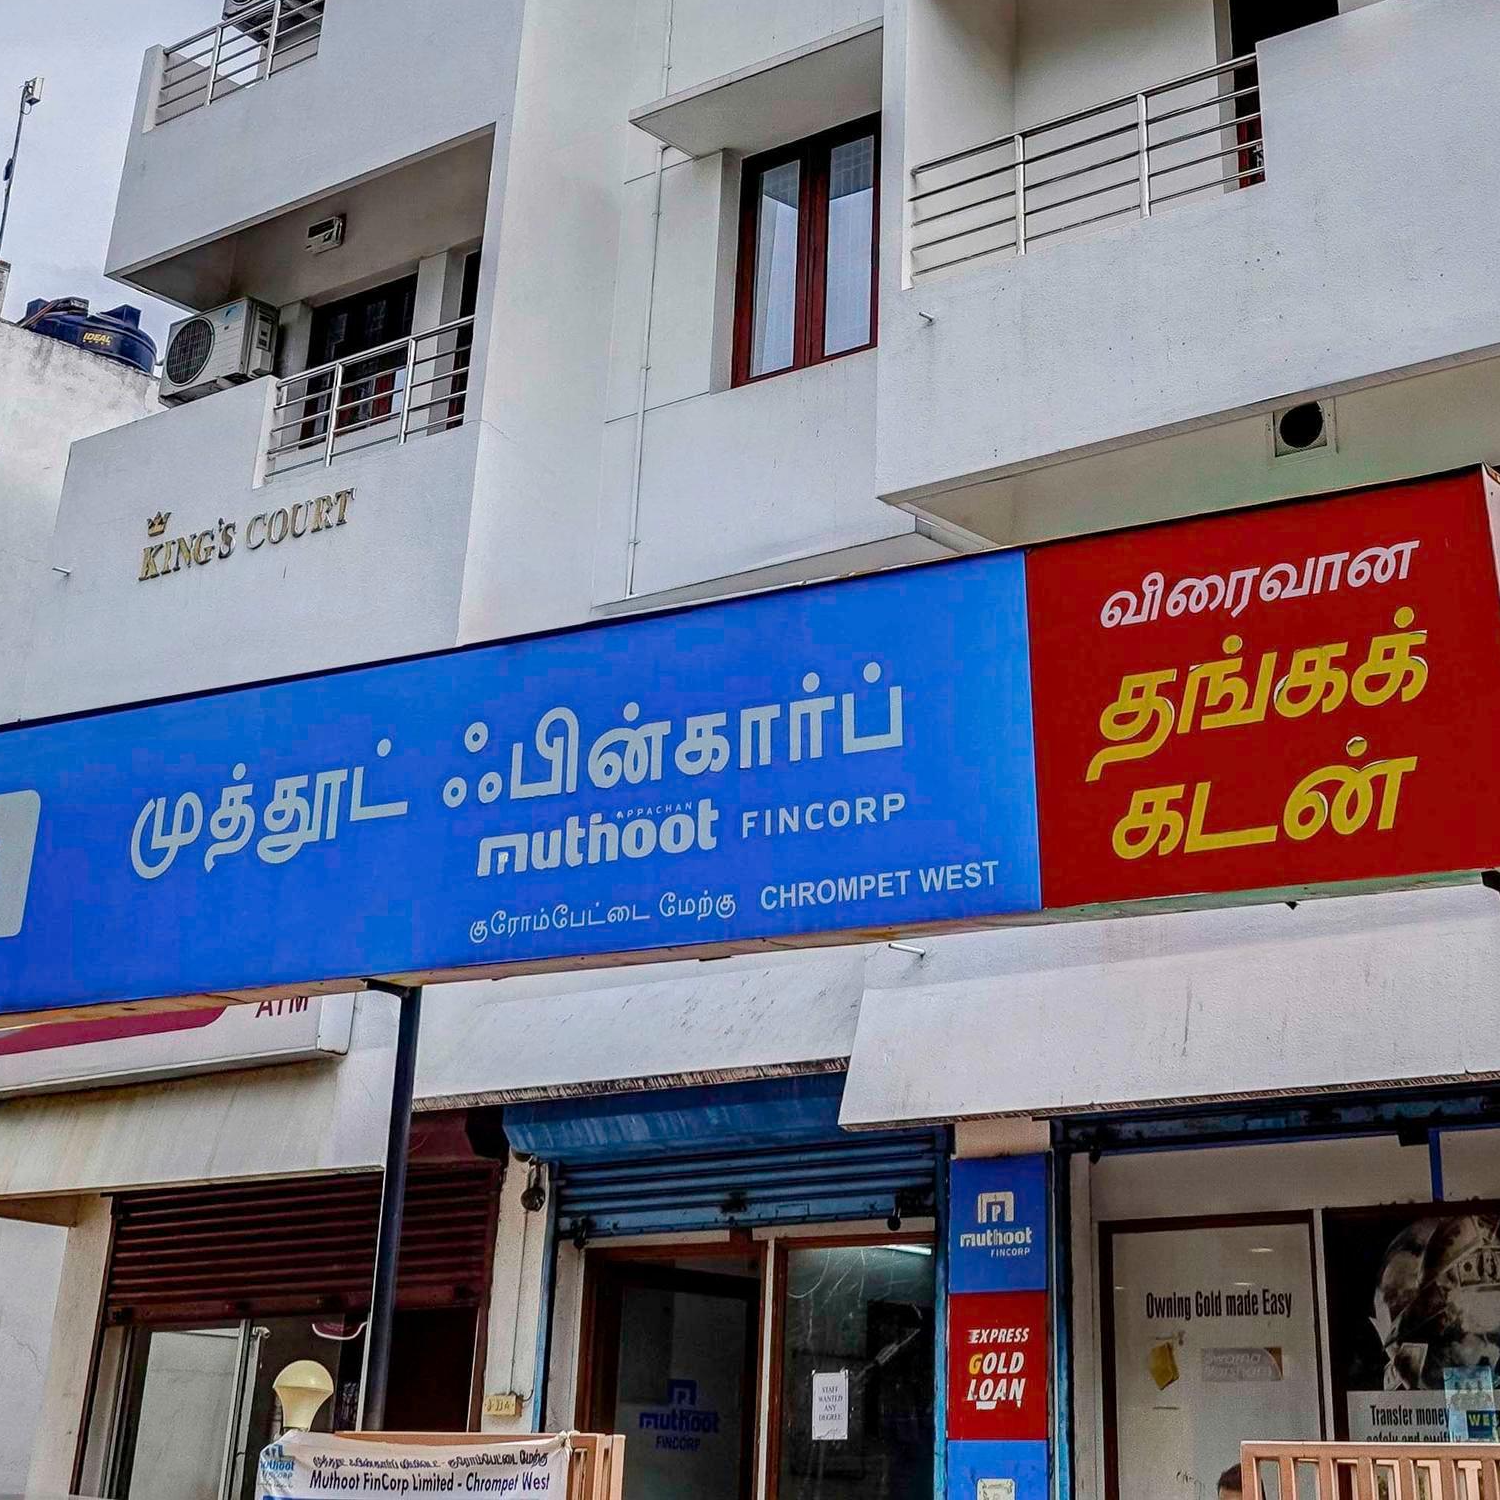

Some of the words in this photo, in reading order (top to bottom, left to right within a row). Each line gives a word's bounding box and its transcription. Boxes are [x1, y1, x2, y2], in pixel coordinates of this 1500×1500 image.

[83, 332, 112, 343] IDEAL
[138, 517, 237, 582] KING'S
[246, 486, 357, 550] COURT
[1100, 540, 1421, 629] விரைவான
[1085, 606, 1430, 784] தங்கக்
[130, 738, 409, 880] முத்தூட்
[442, 661, 905, 809] ஃபின்கார்ப்
[1111, 736, 1418, 861] கடன்
[477, 798, 720, 877] muthoot
[741, 792, 906, 840] FINCORP
[759, 870, 912, 912] CHROMPET
[918, 860, 1000, 894] WEST
[469, 902, 651, 944] குரோம்பேட்டை
[659, 889, 737, 922] மேற்கு
[960, 1226, 1033, 1248] muthoot
[990, 1246, 1031, 1258] FINCORP
[1146, 1292, 1192, 1321] Owning
[1195, 1290, 1222, 1317] Gold
[1226, 1288, 1258, 1316] made
[1262, 1288, 1292, 1318] Easy
[967, 1327, 1031, 1345] EXPRESS
[969, 1351, 1025, 1376] GOLD
[967, 1377, 1026, 1404] LOAN
[639, 1408, 719, 1433] muthoot
[1370, 1404, 1414, 1427] Transfer
[1416, 1407, 1449, 1429] money
[309, 1468, 360, 1491] Muthoot
[363, 1471, 410, 1497] FinCorp
[412, 1472, 455, 1492] Limited
[465, 1472, 518, 1497] Chrompet
[521, 1471, 551, 1491] West
